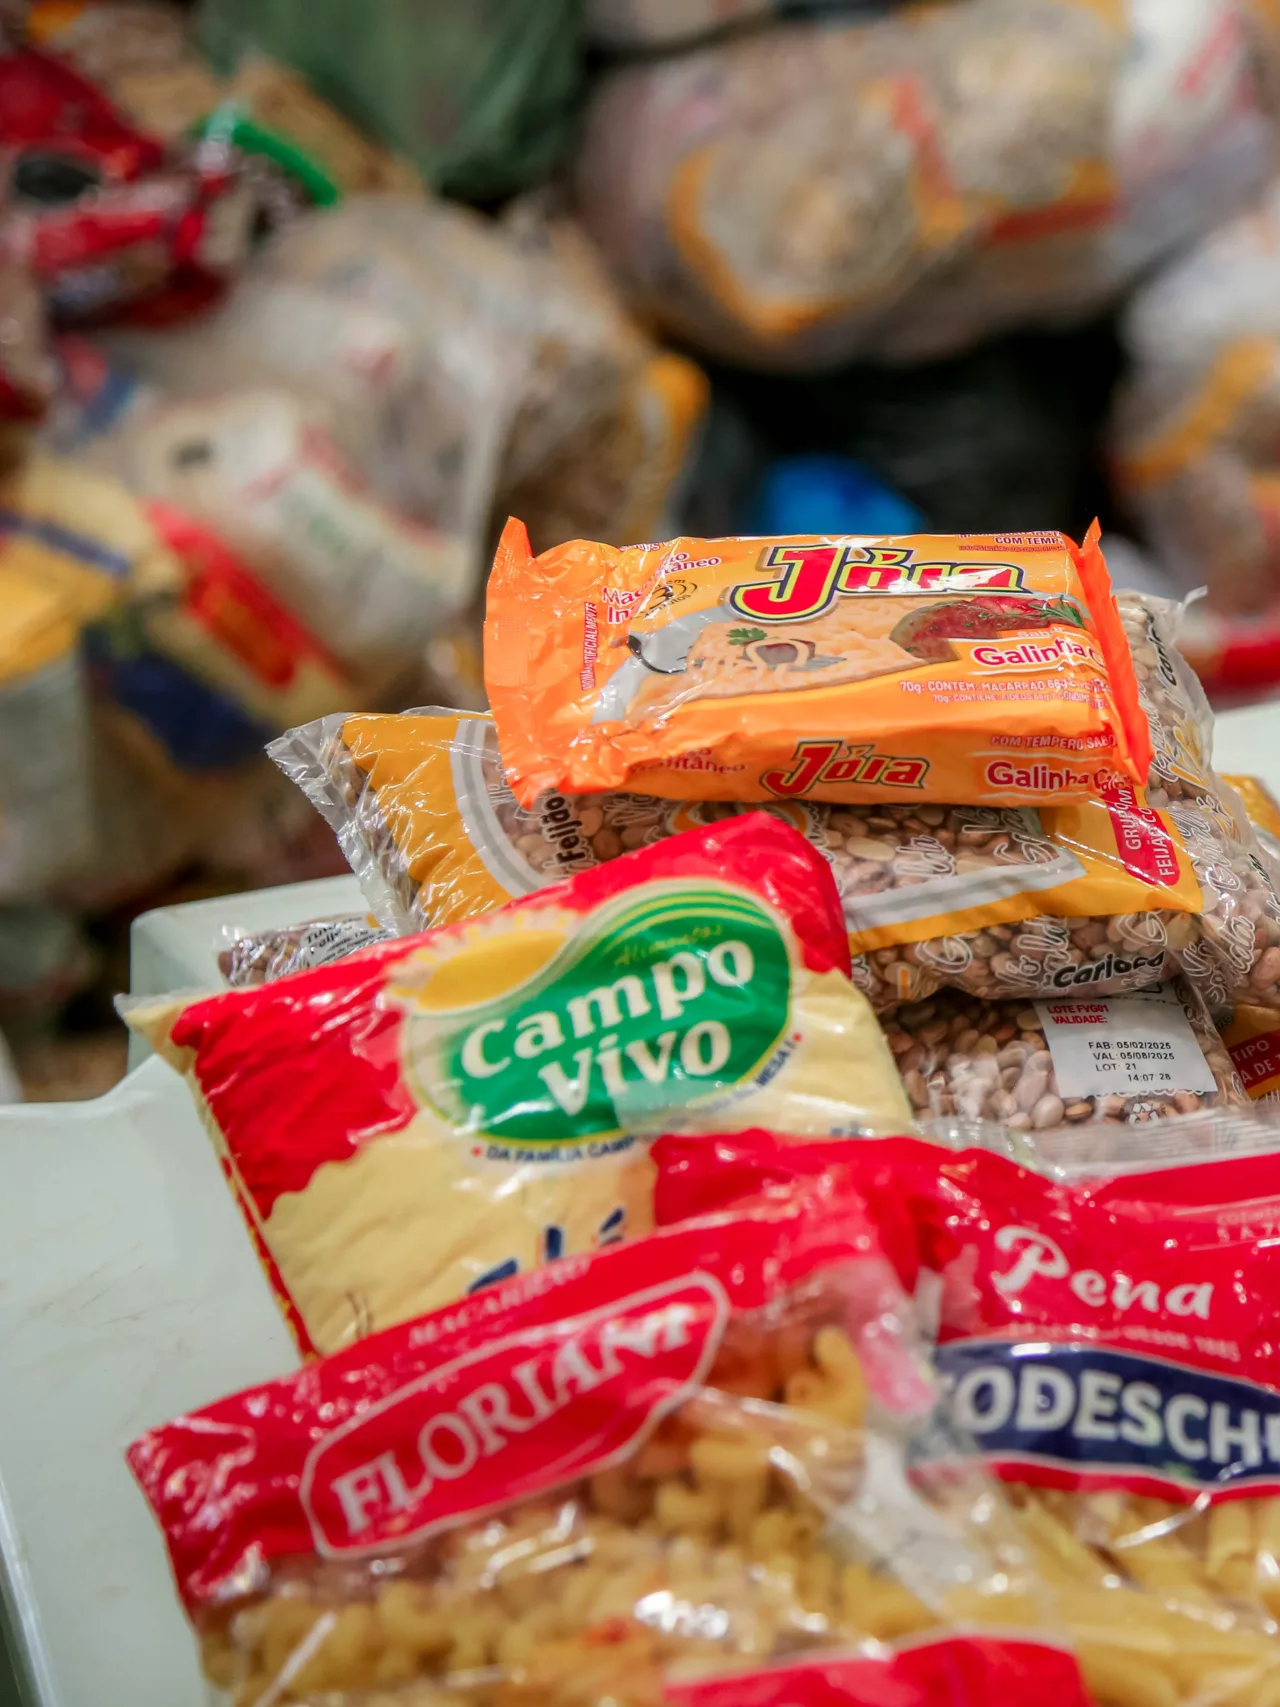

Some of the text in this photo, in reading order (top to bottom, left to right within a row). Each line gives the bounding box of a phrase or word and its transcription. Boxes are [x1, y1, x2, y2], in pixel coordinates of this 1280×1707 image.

[995, 536, 1064, 545] COM TEMP
[972, 637, 1087, 667] Galinha
[990, 734, 1084, 751] COM TEMPERO
[986, 762, 1089, 791] Galinha
[1053, 949, 1166, 989] Carioca
[460, 940, 756, 1080] Campo
[1047, 1004, 1076, 1015] LOTE
[1052, 1015, 1108, 1025] VALIDADE:
[1088, 1041, 1172, 1050] FAB: 05/02/2025
[1232, 1040, 1270, 1062] TIPO
[1120, 1051, 1175, 1060] 05/08/2025
[538, 1020, 732, 1116] Vivo
[1125, 1063, 1137, 1071] 21
[993, 1224, 1215, 1320] Pena
